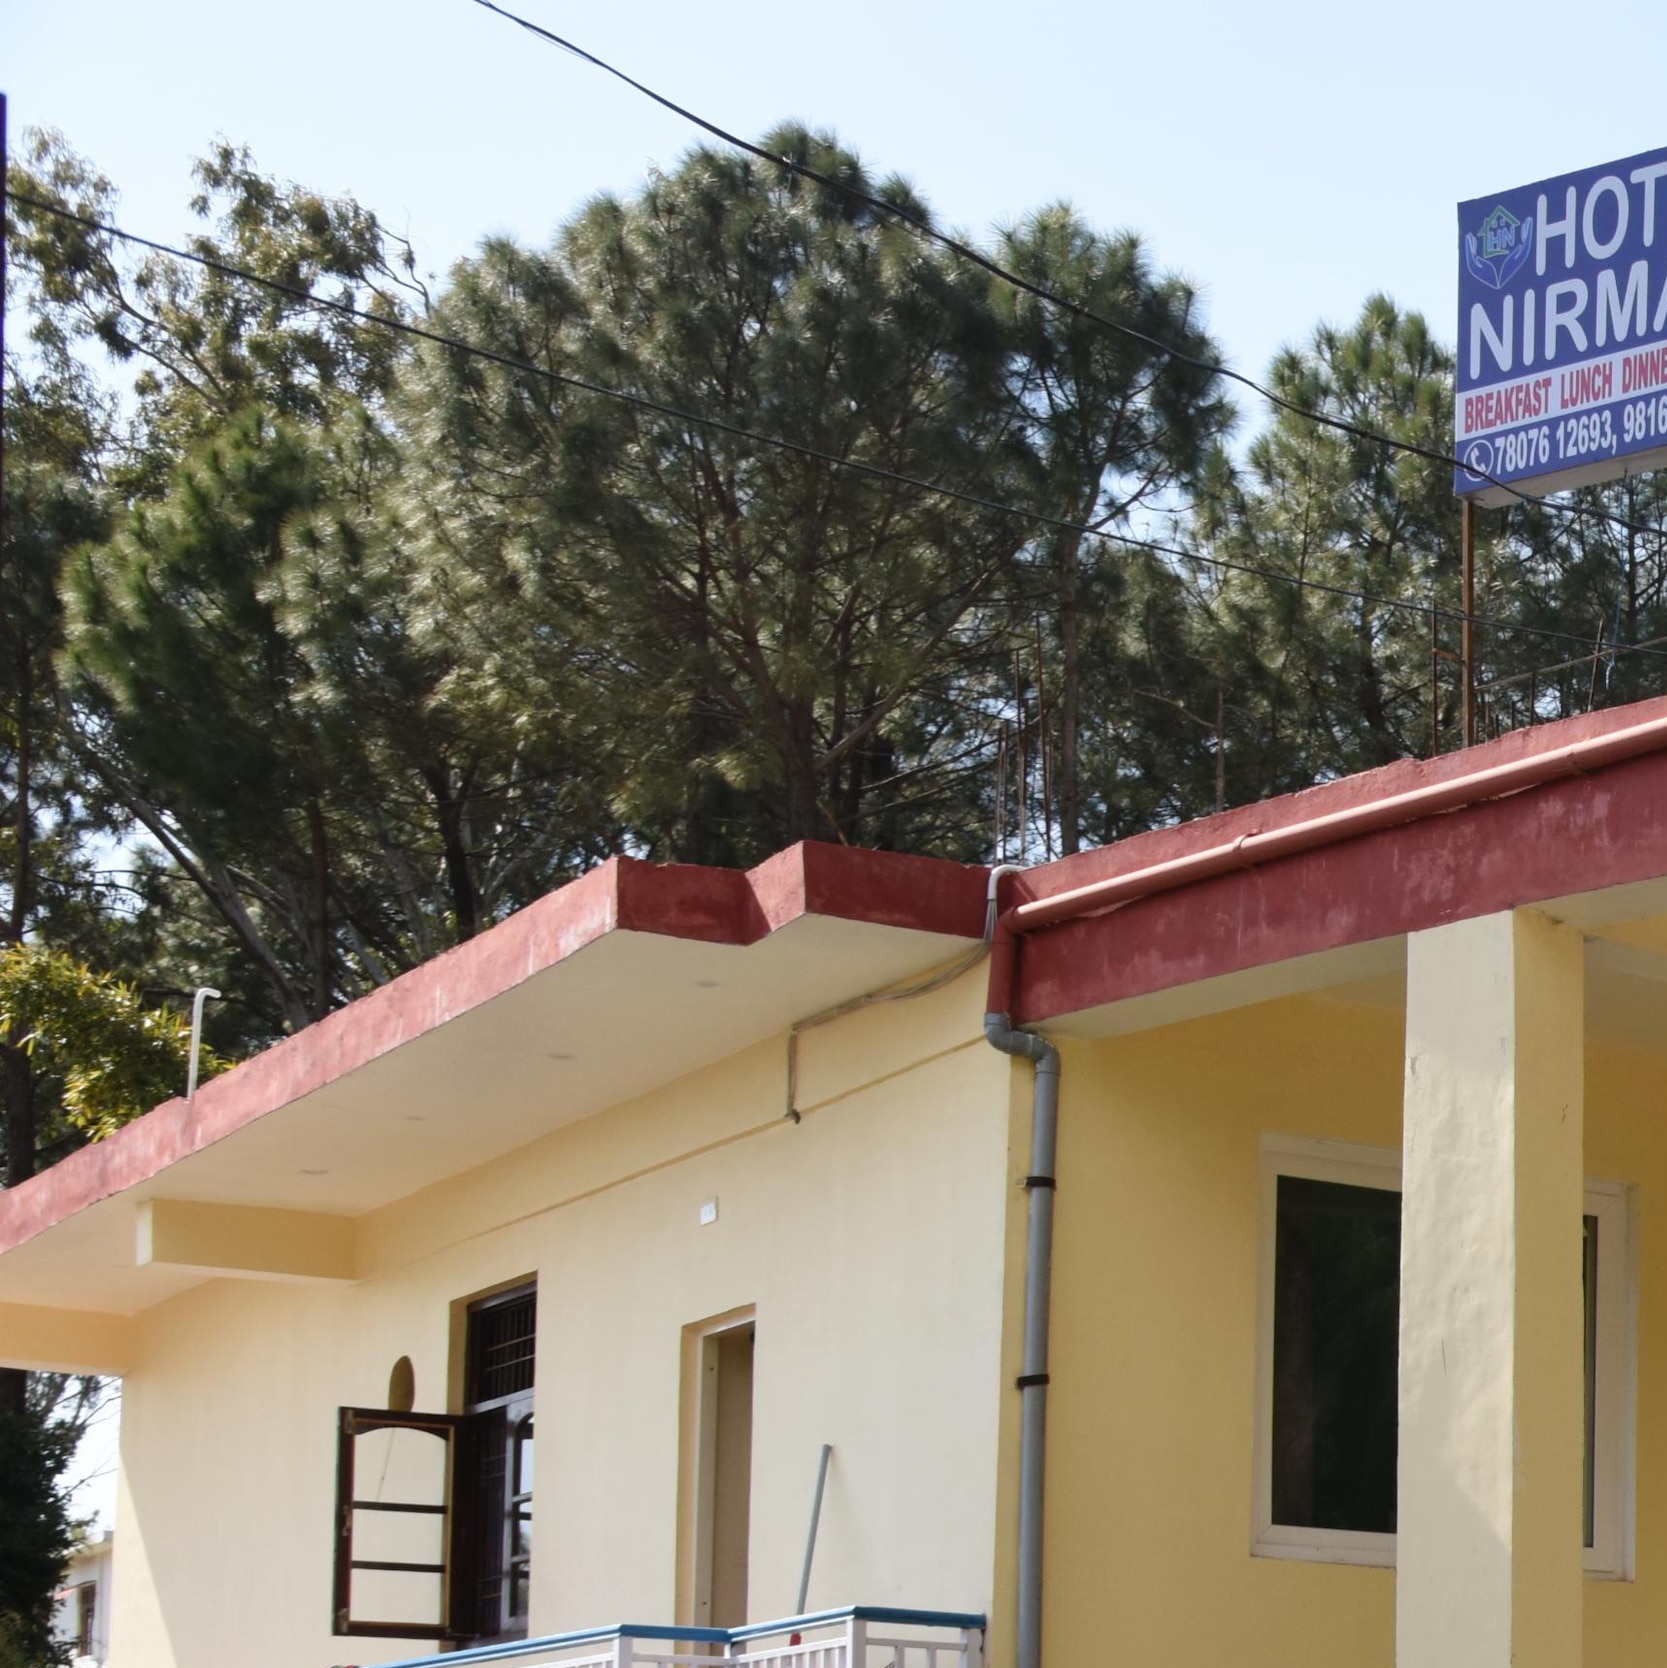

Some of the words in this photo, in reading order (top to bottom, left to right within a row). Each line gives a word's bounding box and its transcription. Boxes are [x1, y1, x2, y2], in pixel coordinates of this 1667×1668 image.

[1464, 378, 1552, 433] BREAKFAST
[1560, 361, 1612, 409] LUNCH
[1495, 420, 1549, 474] 78076
[1556, 410, 1616, 458] 12693,
